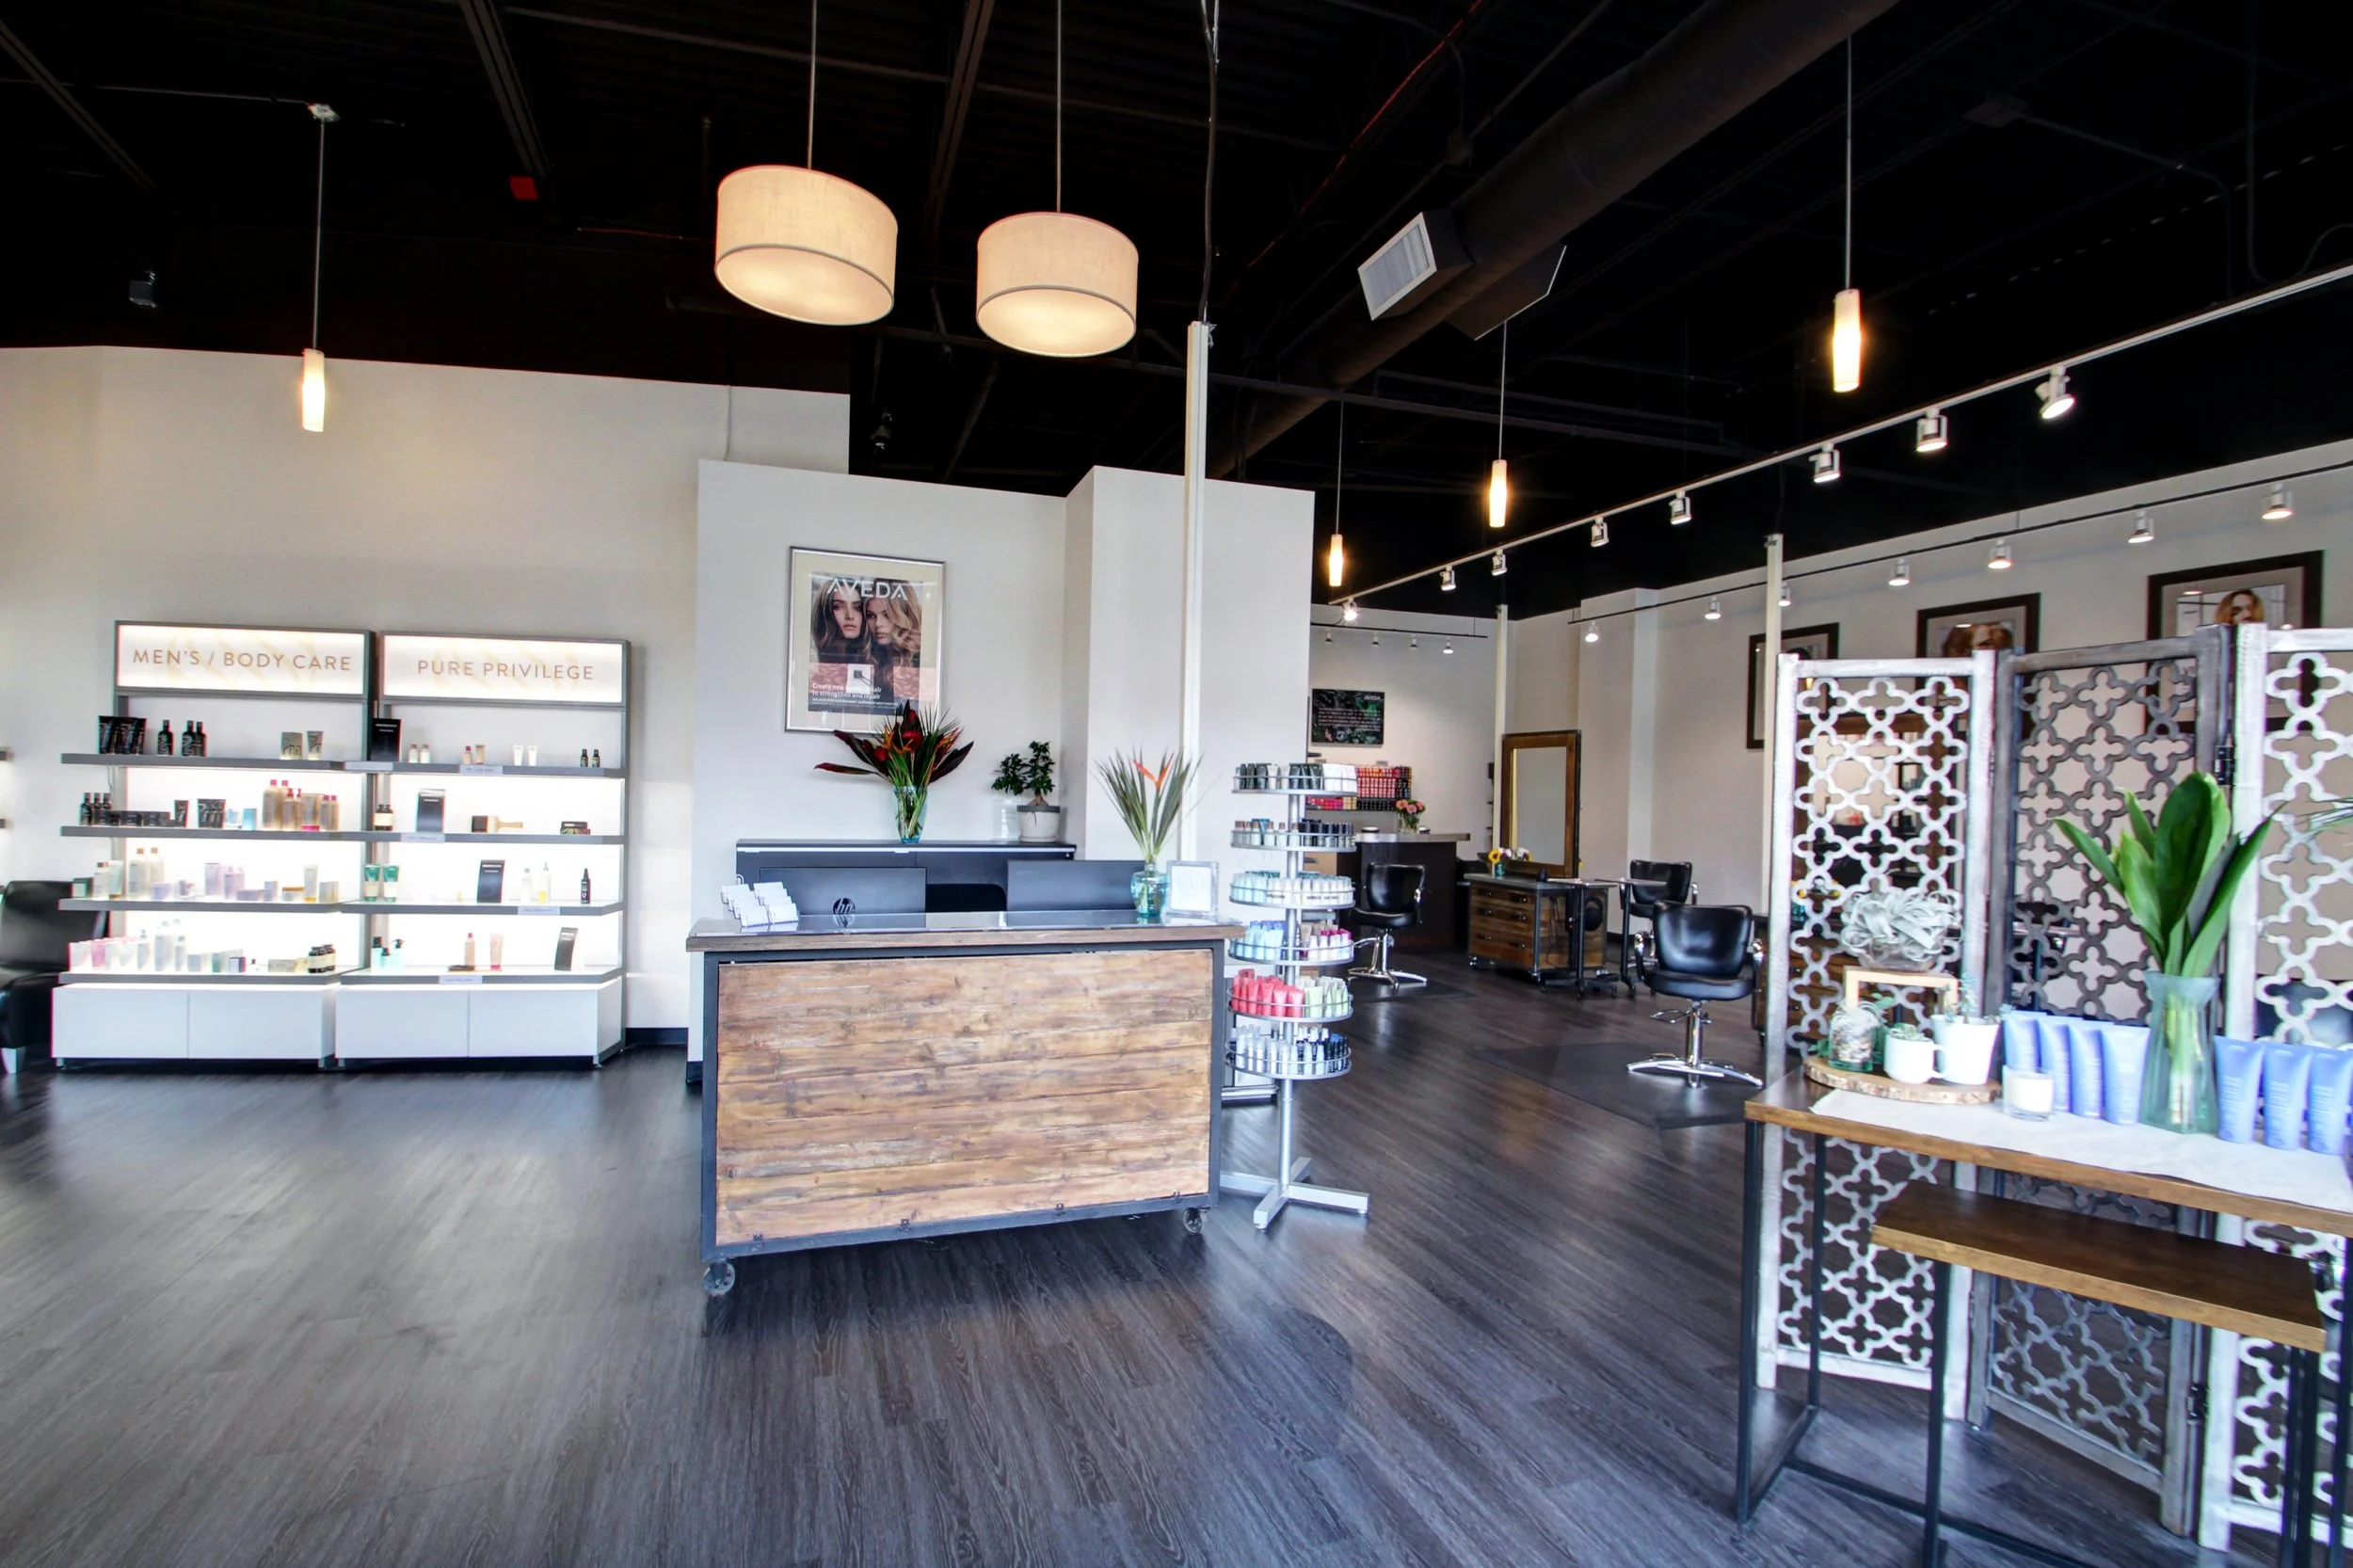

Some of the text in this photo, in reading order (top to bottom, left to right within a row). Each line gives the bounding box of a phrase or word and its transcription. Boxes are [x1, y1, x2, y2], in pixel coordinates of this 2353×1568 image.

[826, 578, 908, 600] AVEDA
[133, 648, 351, 671] MEN'S / BODY CARE
[418, 660, 594, 680] PURE PRIVILEGE
[812, 682, 831, 691] Create
